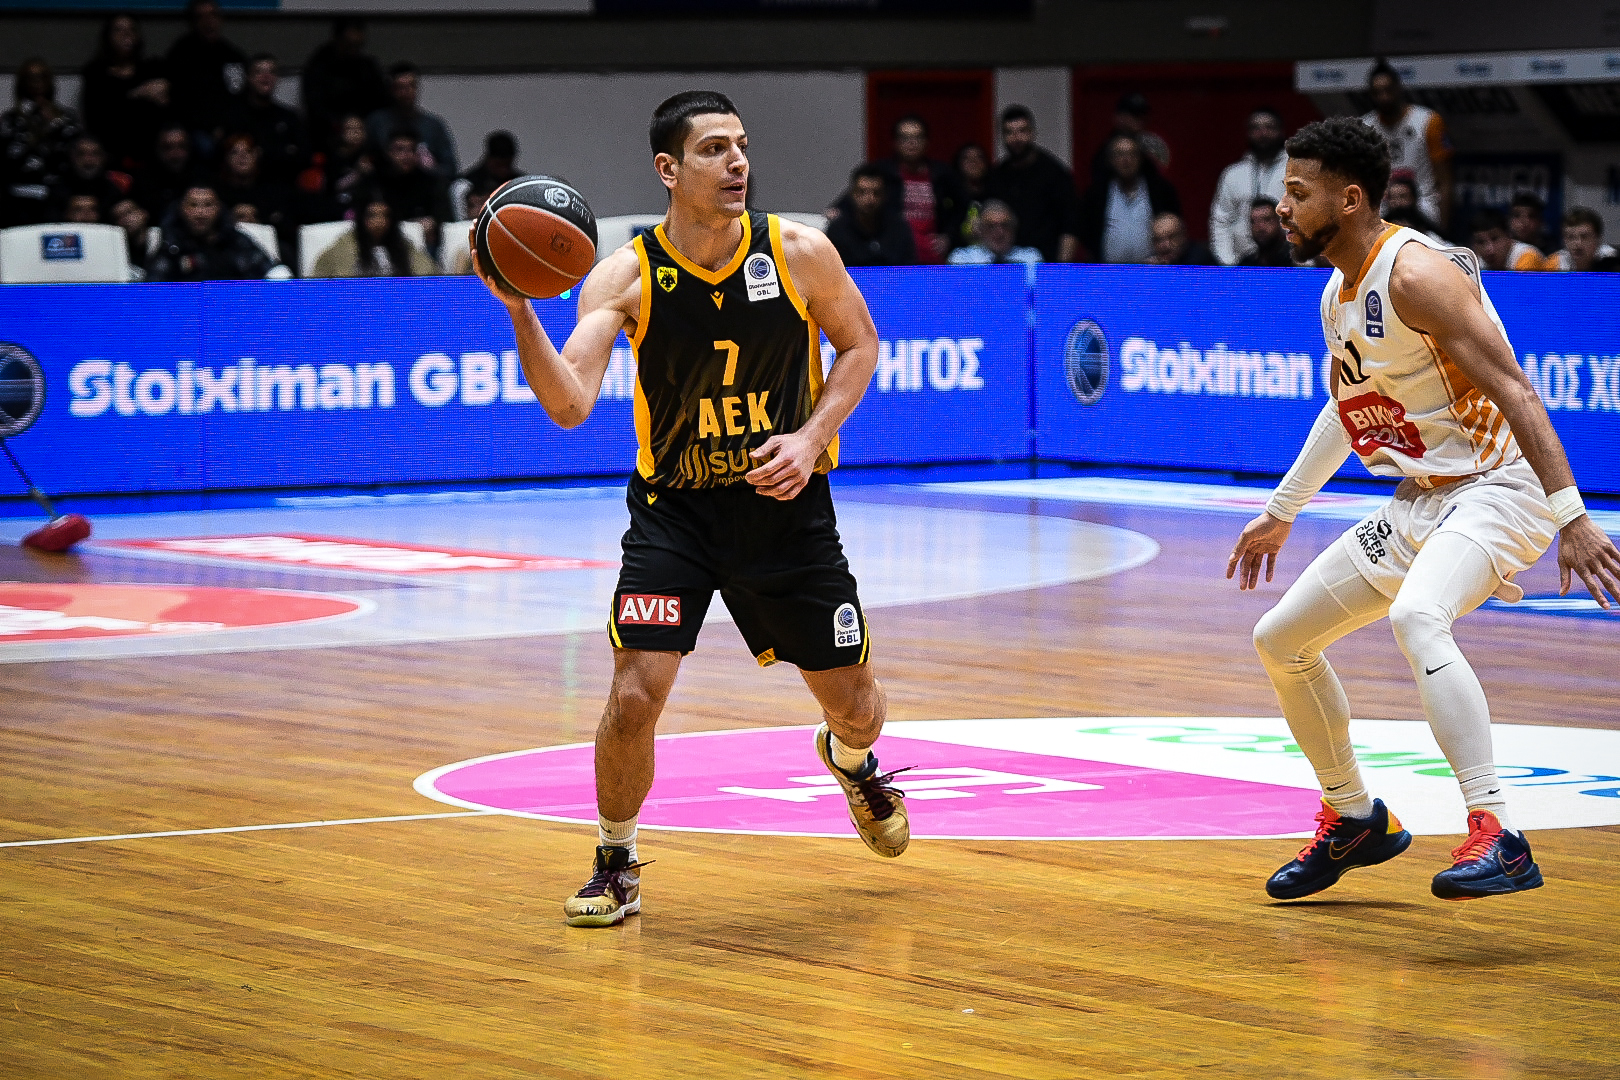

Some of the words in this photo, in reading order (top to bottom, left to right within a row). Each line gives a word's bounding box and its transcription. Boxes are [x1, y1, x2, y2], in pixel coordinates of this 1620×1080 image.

[69, 358, 396, 417] Stoiximan
[409, 350, 539, 407] GBL
[713, 339, 740, 386] 7
[1119, 337, 1313, 400] Stoiximan
[698, 390, 773, 439] AEK
[1355, 526, 1379, 565] CARGO
[1363, 520, 1386, 558] SUPER
[619, 597, 680, 623] AVIS
[837, 633, 859, 645] GBL
